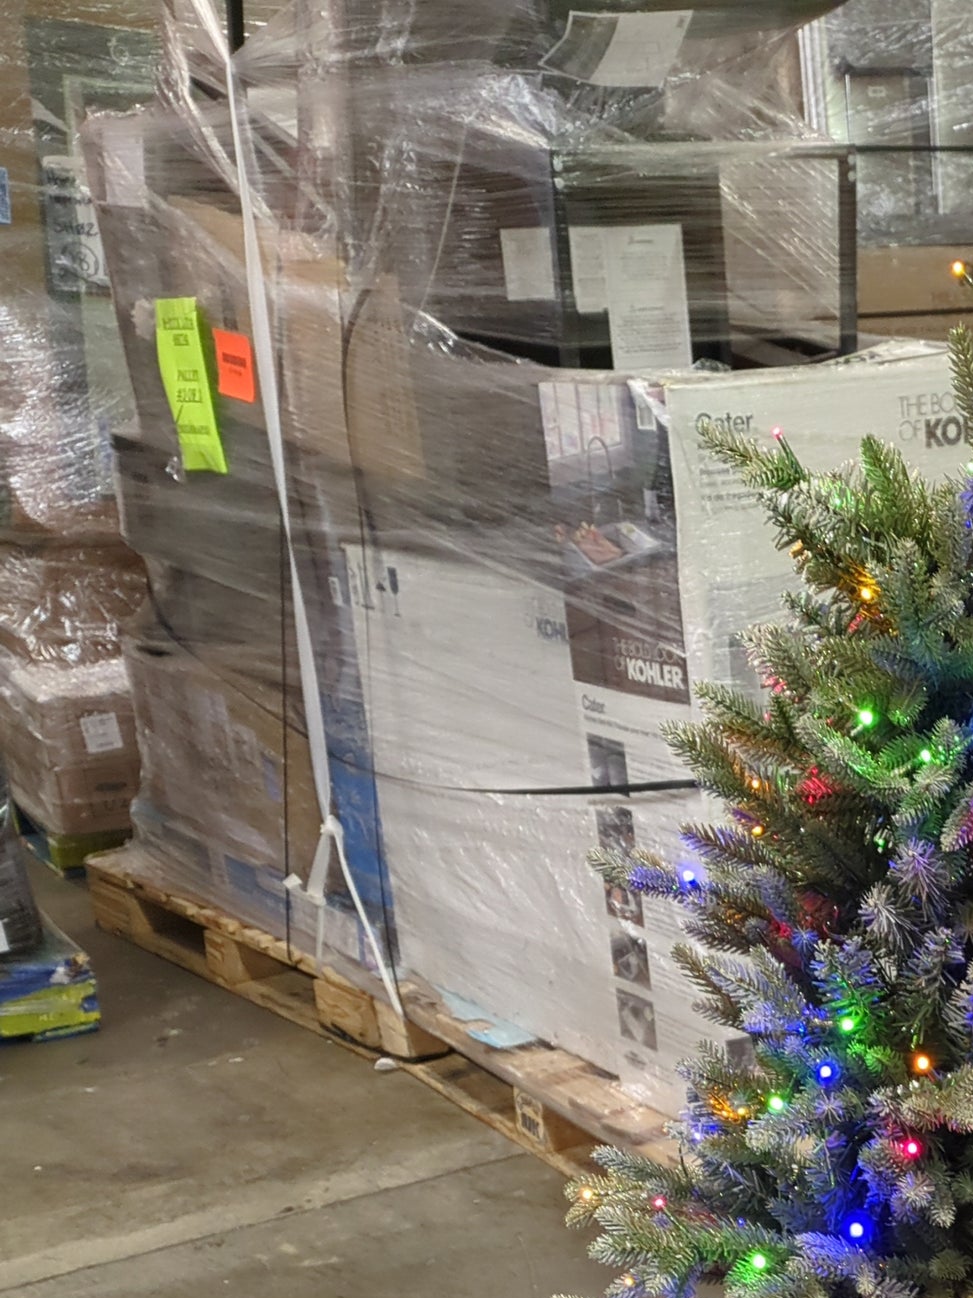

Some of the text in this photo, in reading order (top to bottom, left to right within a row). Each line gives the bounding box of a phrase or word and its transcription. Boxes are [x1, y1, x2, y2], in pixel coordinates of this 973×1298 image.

[898, 394, 927, 418] THE
[899, 419, 921, 442] OF
[626, 657, 684, 690] KOHLER
